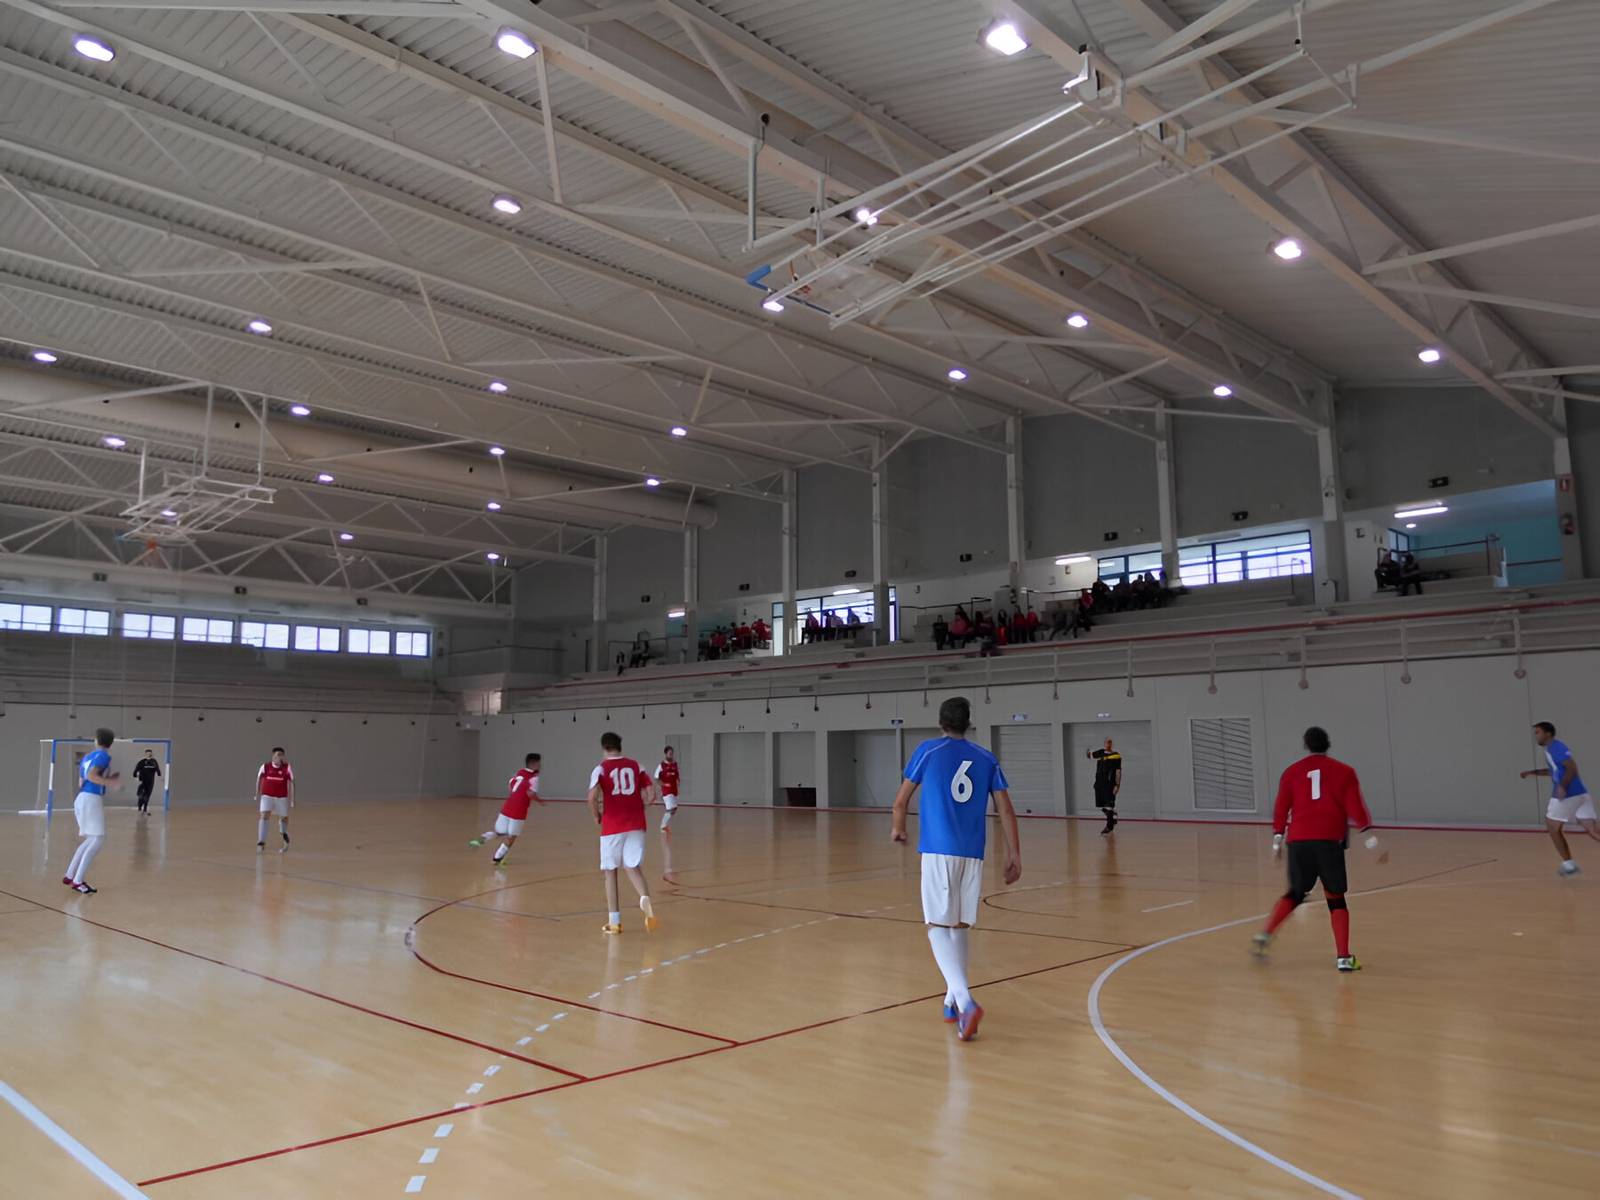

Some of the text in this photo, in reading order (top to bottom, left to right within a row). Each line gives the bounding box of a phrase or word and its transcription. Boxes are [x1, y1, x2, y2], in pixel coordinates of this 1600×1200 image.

[609, 767, 636, 796] 10
[950, 760, 973, 803] 6
[1306, 768, 1321, 800] 1
